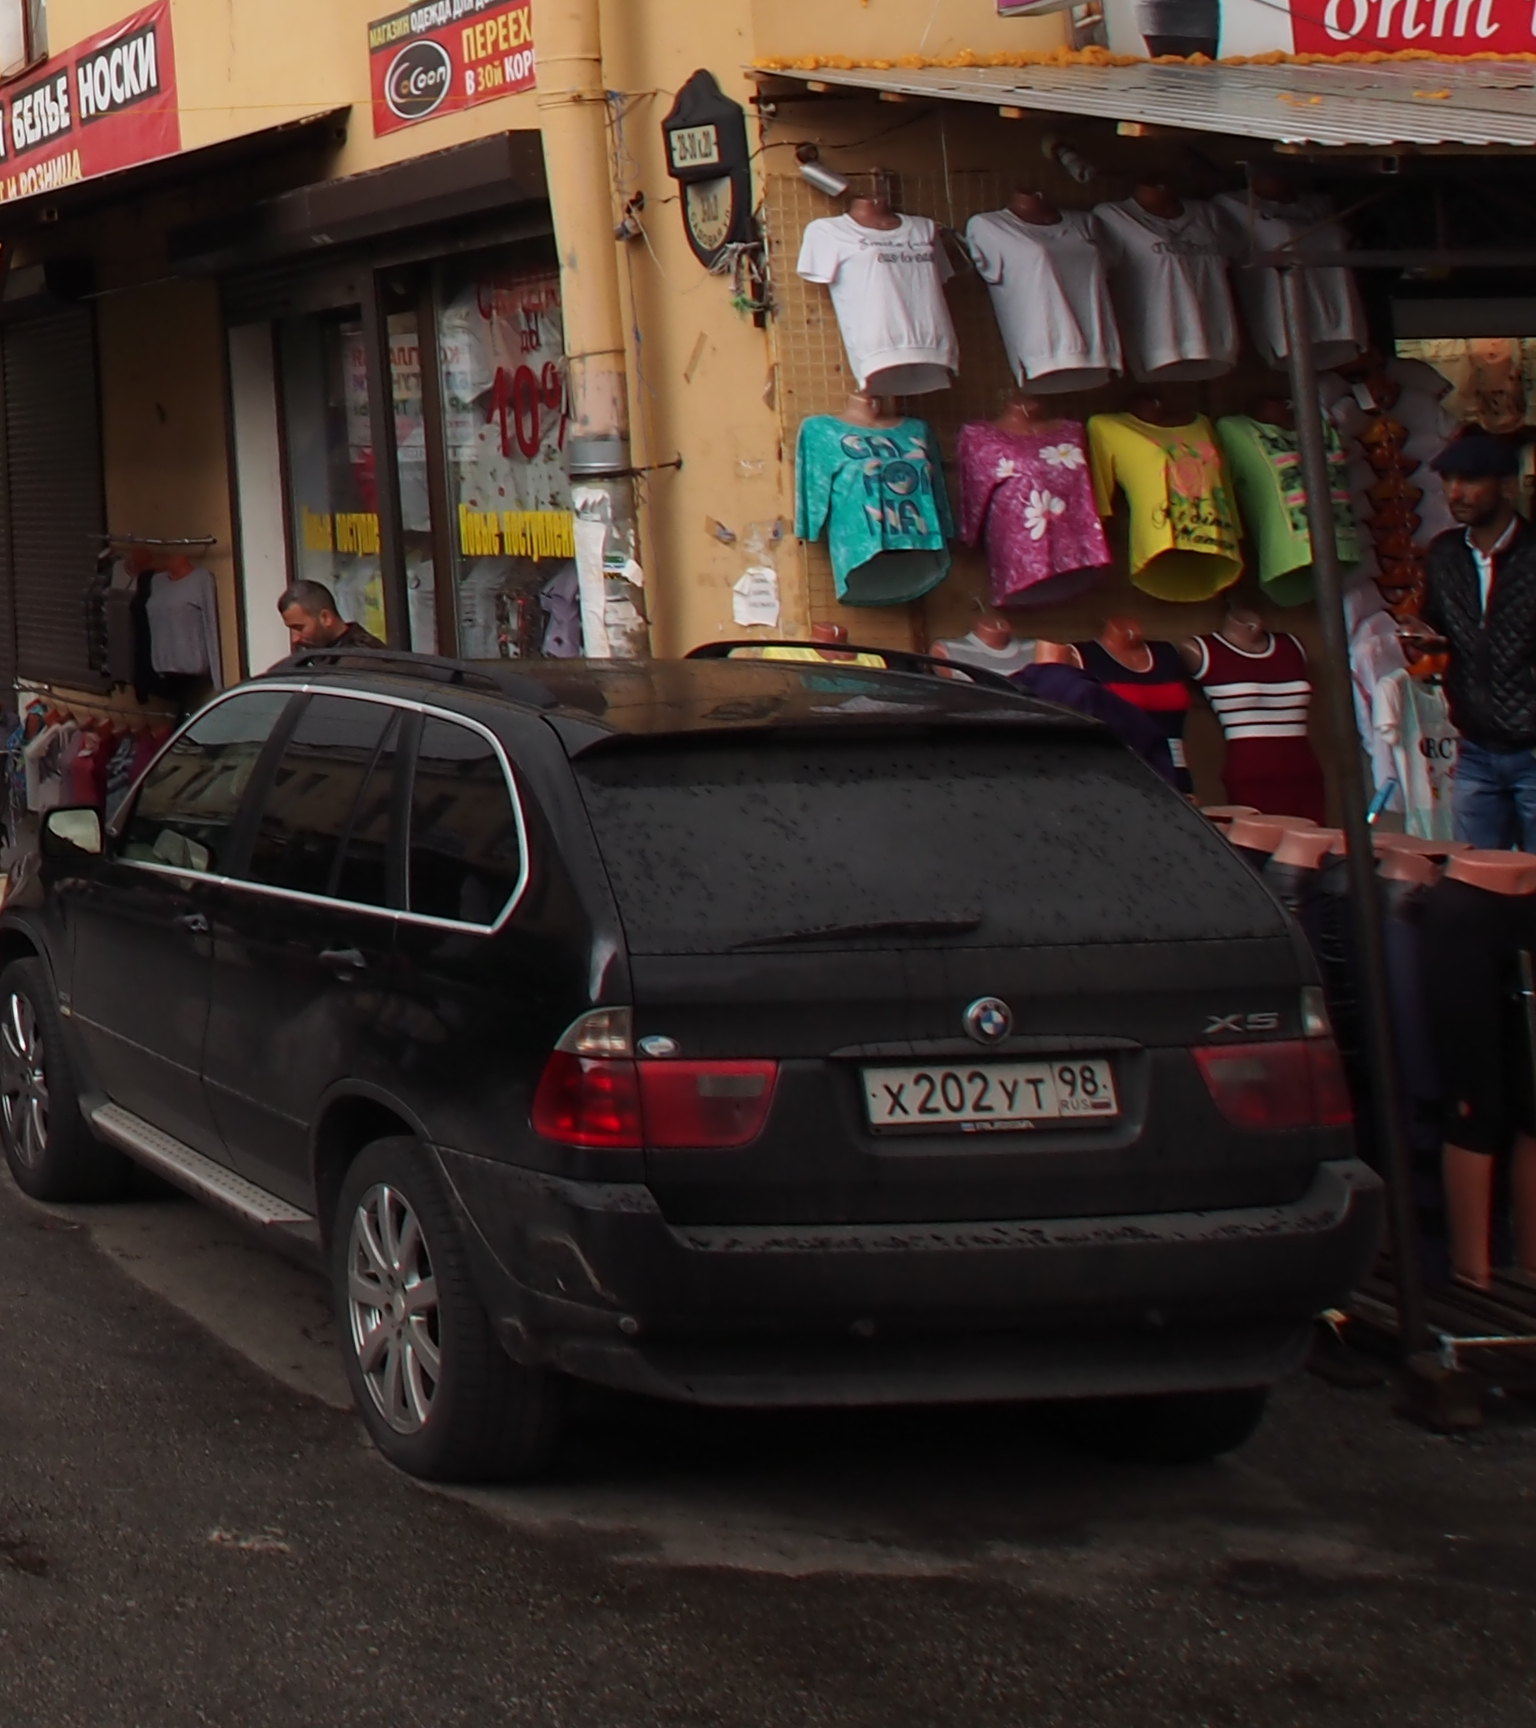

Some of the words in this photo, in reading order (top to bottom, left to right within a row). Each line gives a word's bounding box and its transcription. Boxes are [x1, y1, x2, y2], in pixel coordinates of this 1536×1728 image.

[369, 13, 410, 50] МАГАЗИН
[11, 75, 71, 151] БЕЛЬЕ
[77, 31, 159, 120] НОСКИ
[465, 69, 476, 96] В
[18, 148, 83, 197] РОЗНИЦА
[1202, 1011, 1280, 1034] X5
[1057, 1064, 1099, 1098] 98
[1060, 1098, 1090, 1112] RUS
